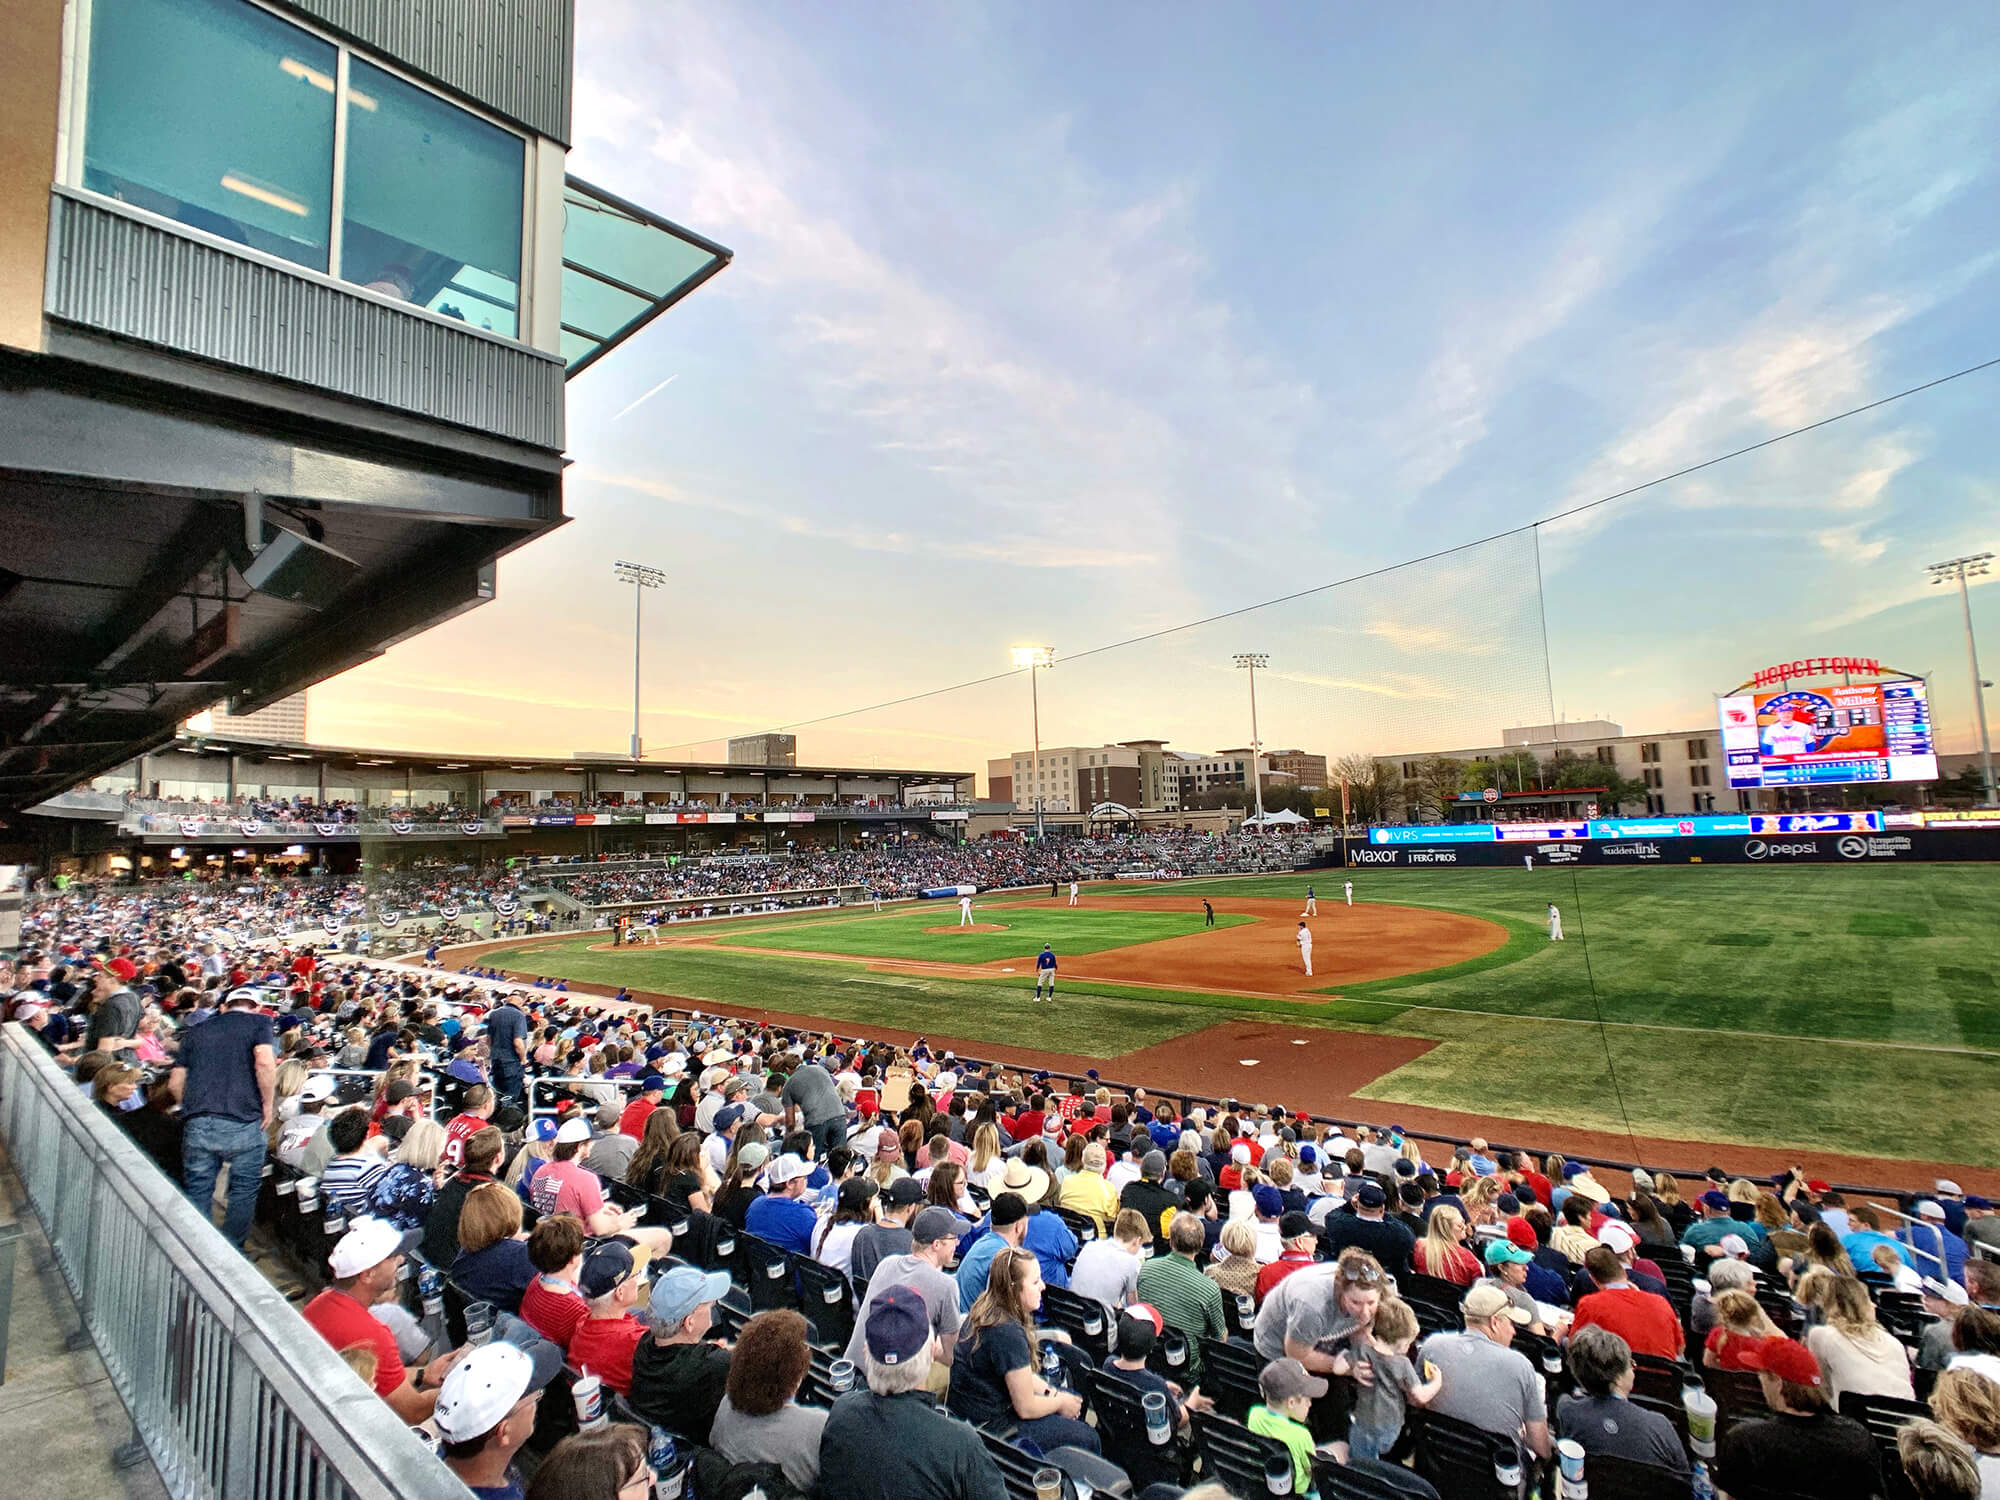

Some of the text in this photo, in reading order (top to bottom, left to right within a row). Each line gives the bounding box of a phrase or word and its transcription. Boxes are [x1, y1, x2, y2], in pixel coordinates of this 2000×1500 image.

[1753, 656, 1880, 689] HODGETOWN
[1835, 696, 1879, 707] Miller
[1868, 837, 1911, 845] Amarillo
[1602, 842, 1662, 856] suddenlink
[1769, 841, 1818, 856] pepsi
[1869, 849, 1897, 858] Bank
[1351, 849, 1399, 863] Maxor
[1435, 853, 1457, 862] PROS
